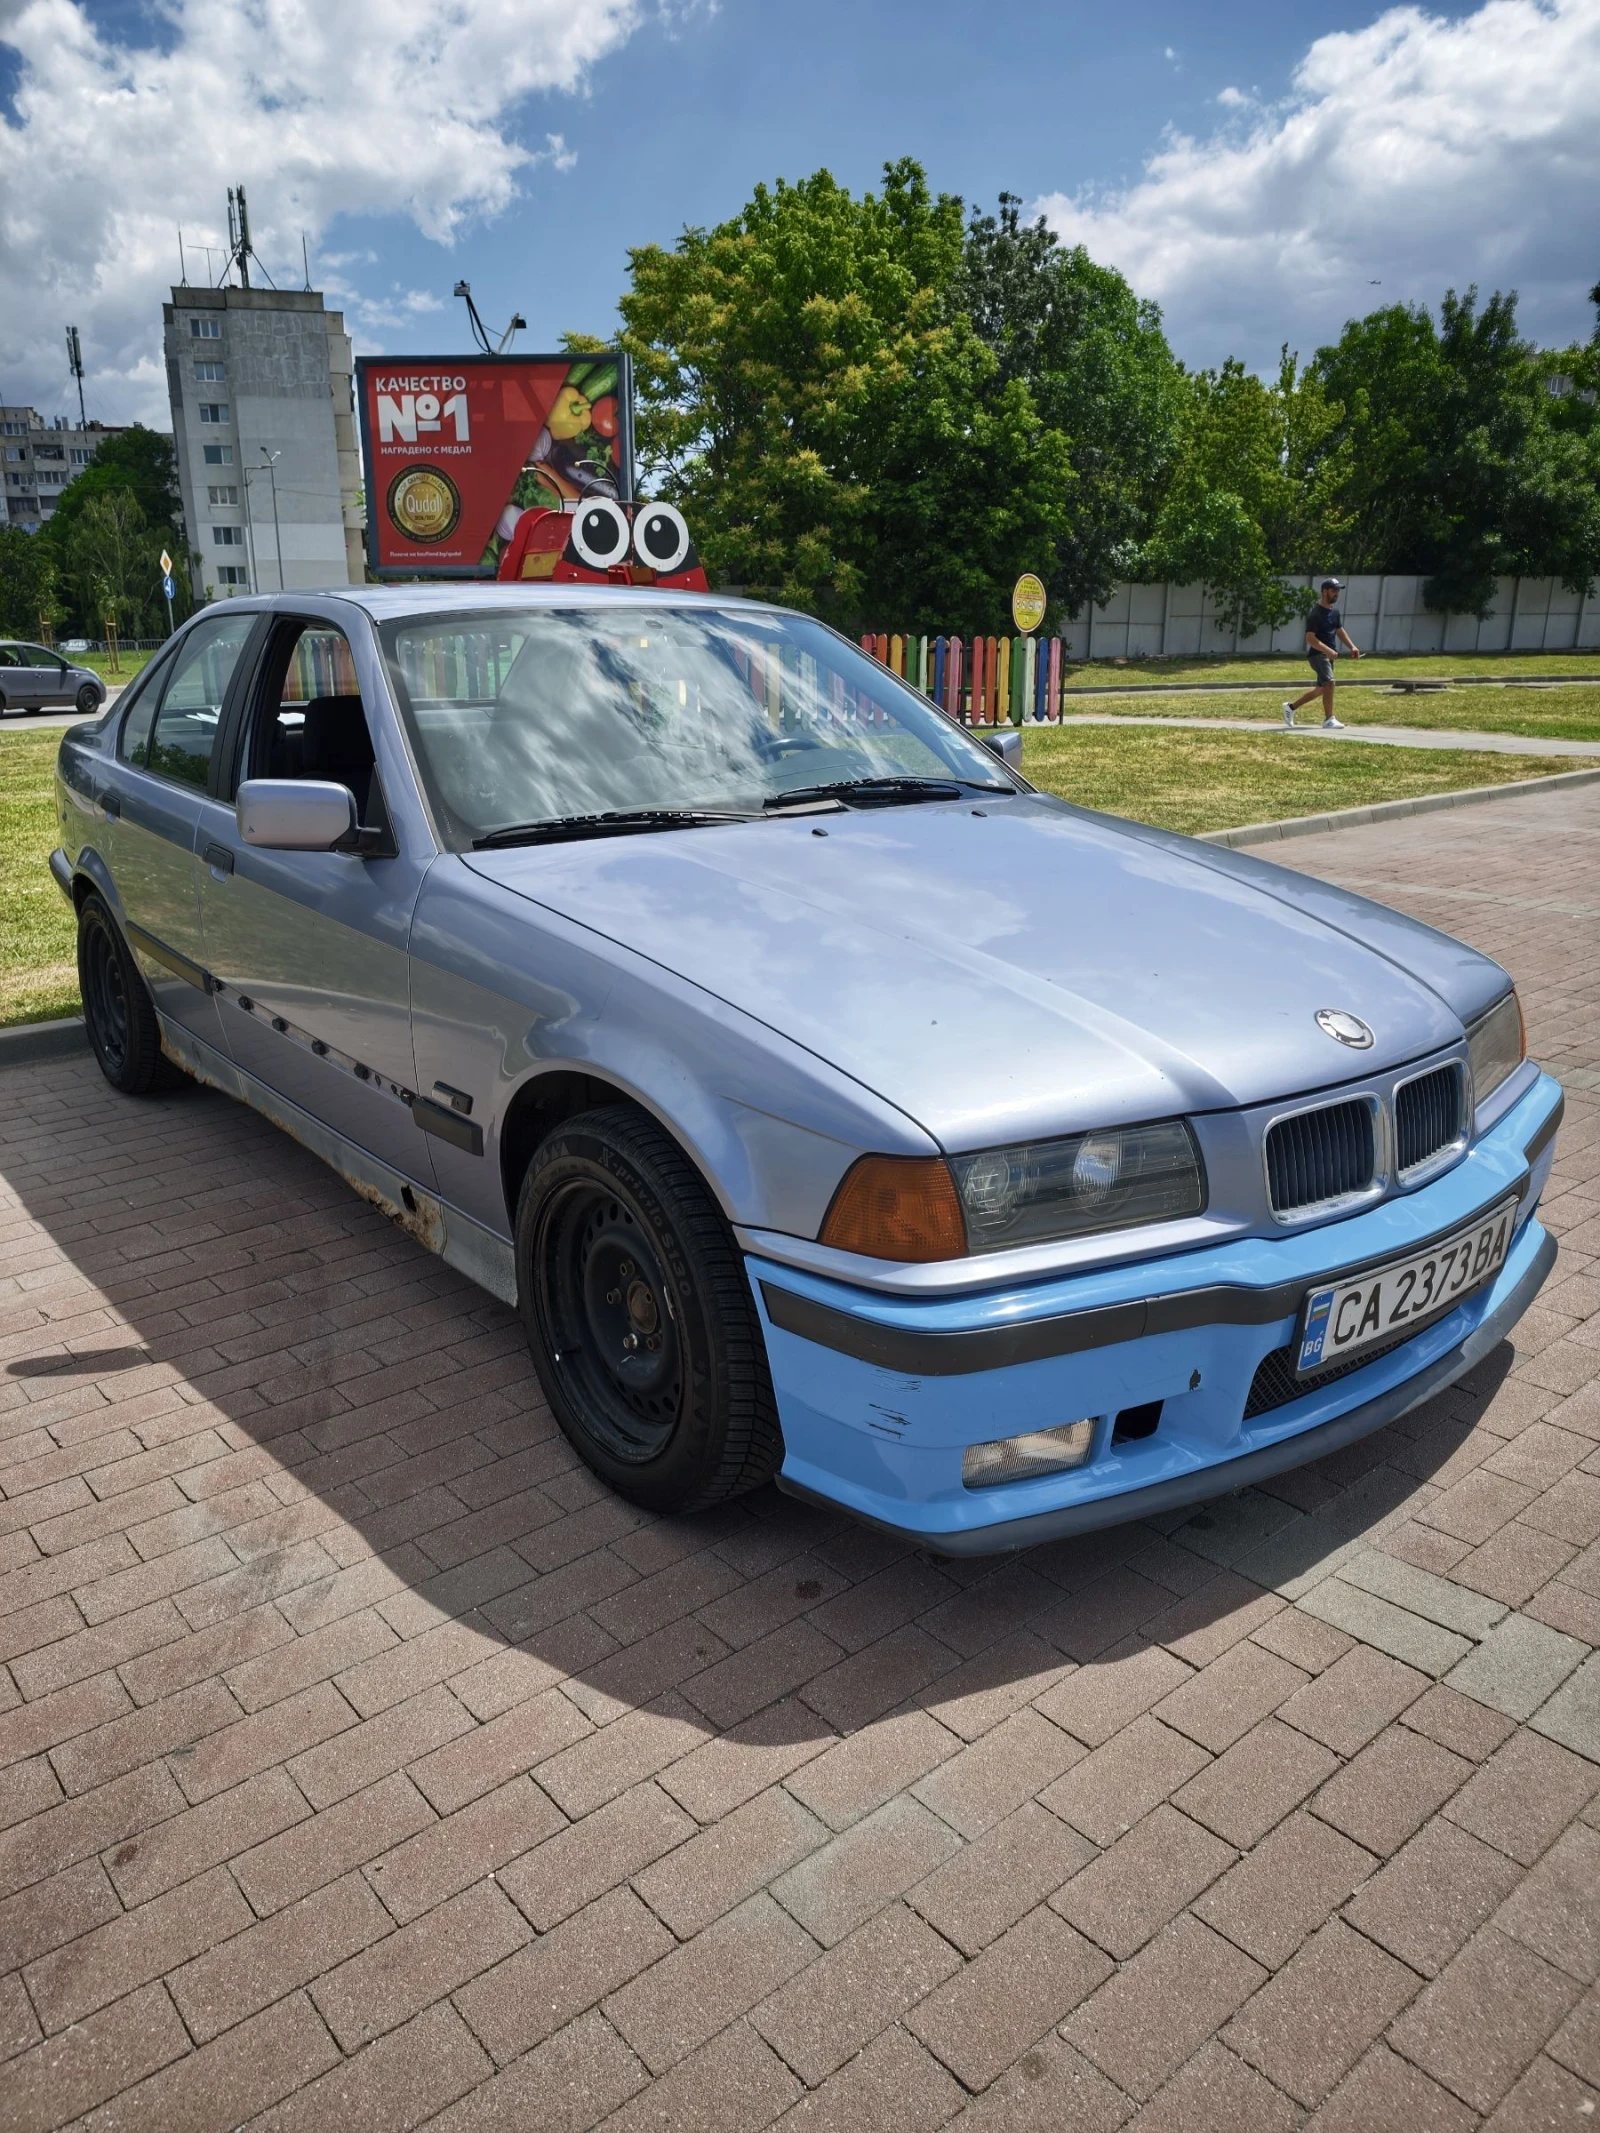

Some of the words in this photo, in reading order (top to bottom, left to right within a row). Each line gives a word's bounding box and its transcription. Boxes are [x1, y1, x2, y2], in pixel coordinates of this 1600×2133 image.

[375, 376, 466, 392] КАЧЕСТВО
[381, 446, 432, 455] НАГРАДЕНО
[440, 445, 472, 455] МЕДАЛ
[406, 493, 441, 513] Qudal
[1333, 1283, 1381, 1346] CA
[1303, 1337, 1323, 1357] BG
